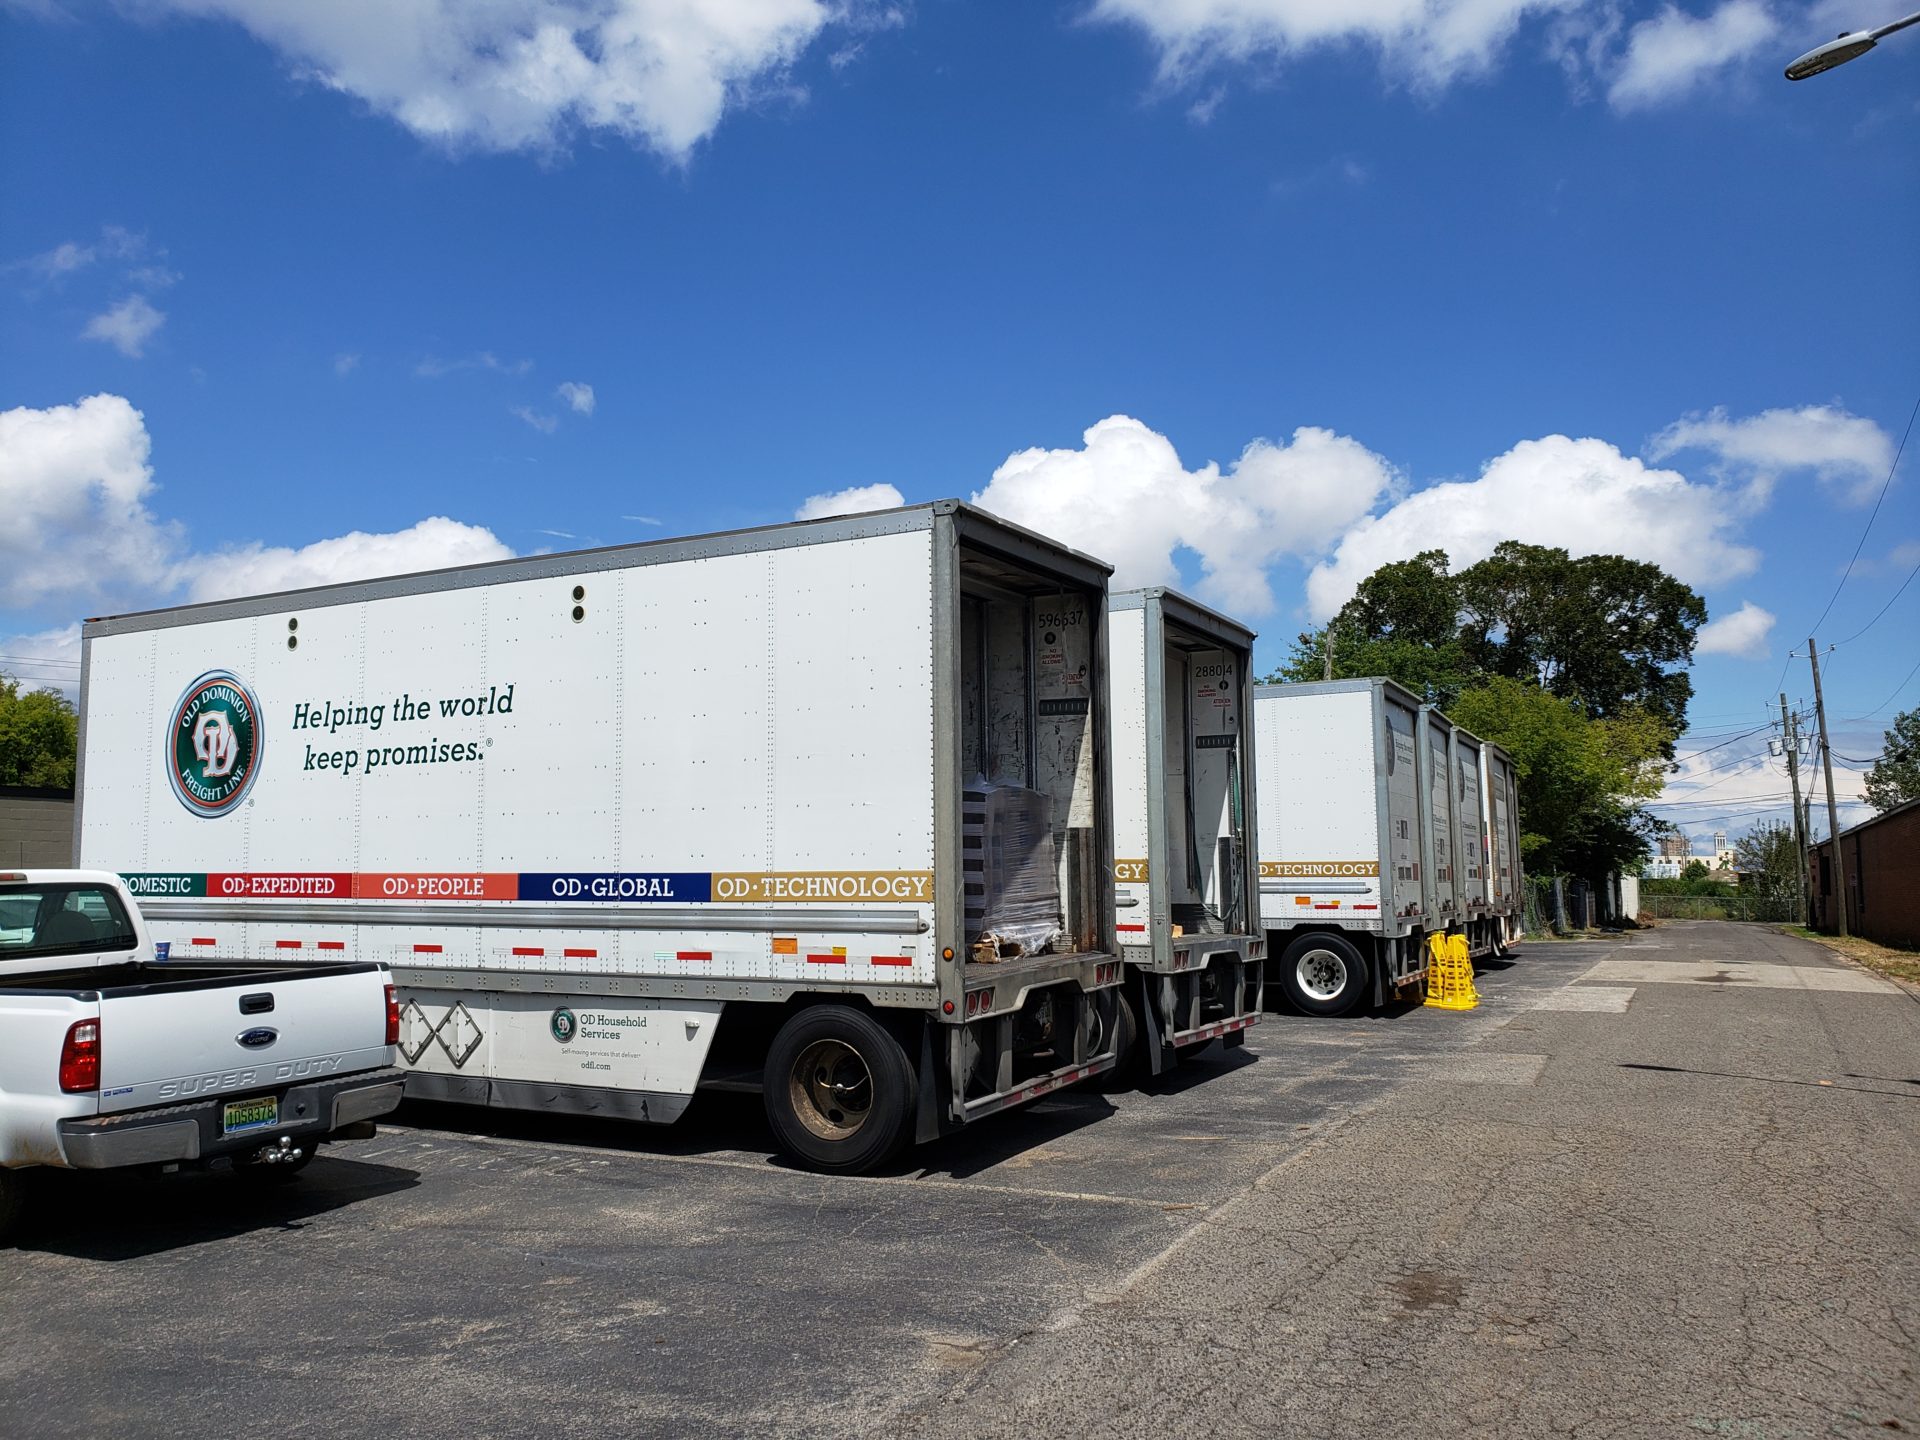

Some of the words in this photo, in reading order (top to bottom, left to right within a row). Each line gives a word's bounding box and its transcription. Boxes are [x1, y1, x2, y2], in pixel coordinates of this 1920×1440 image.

[1039, 610, 1083, 628] 596637
[182, 699, 200, 728] OLD
[201, 686, 250, 723] DOMINION
[292, 702, 385, 733] Helping
[393, 694, 431, 721] the
[439, 684, 515, 719] world
[303, 745, 358, 775] keep
[181, 767, 222, 801] FREIGHT
[224, 764, 247, 794] LINE
[580, 1014, 596, 1025] OD
[597, 1014, 648, 1028] Household
[247, 1030, 270, 1044] Ford
[581, 1027, 621, 1040] Services
[590, 1049, 610, 1057] services
[610, 1050, 621, 1058] that
[580, 1060, 612, 1071] odfl.com
[159, 1069, 258, 1099] SUPER
[275, 1056, 343, 1080] DUTY
